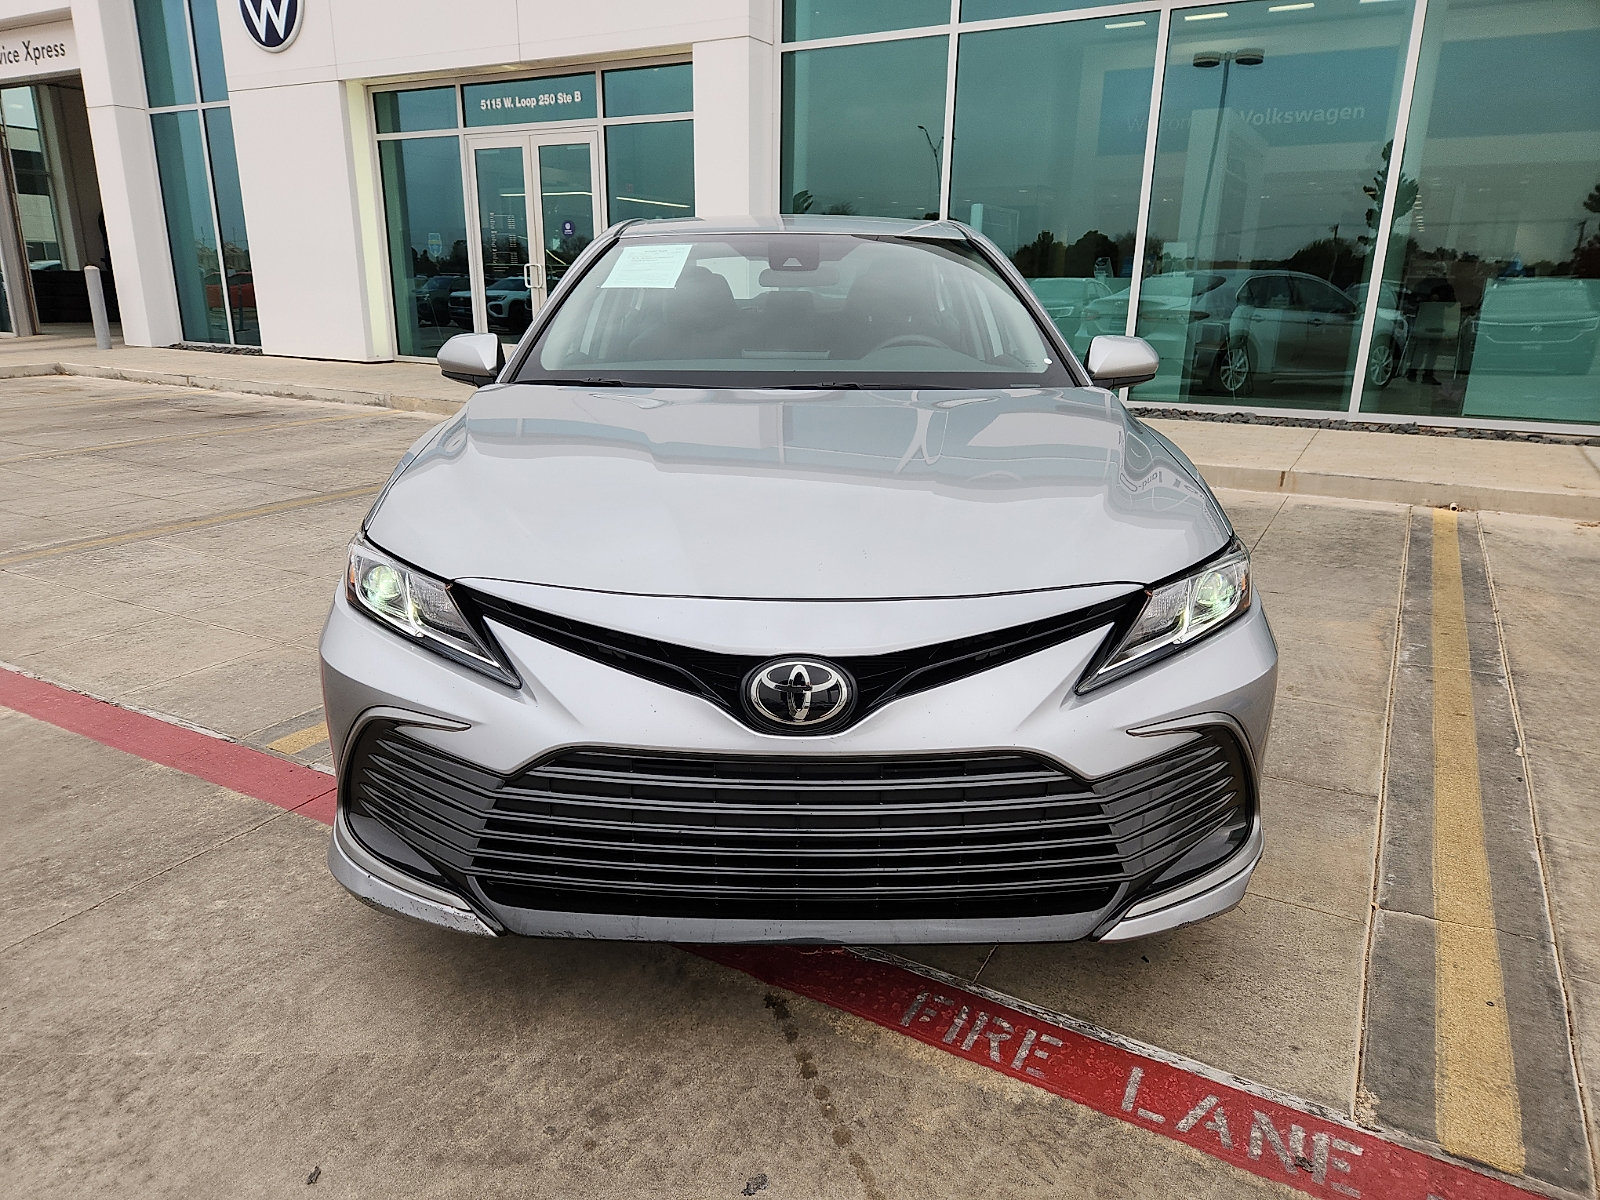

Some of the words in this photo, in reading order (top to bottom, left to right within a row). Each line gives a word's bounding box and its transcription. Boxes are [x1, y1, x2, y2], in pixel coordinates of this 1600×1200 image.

[22, 40, 66, 65] Xpress
[480, 98, 501, 110] 5115
[503, 97, 514, 108] W.
[515, 96, 536, 108] Loop
[538, 94, 555, 106] 250
[557, 92, 572, 104] Ste
[574, 90, 582, 102] B
[1240, 105, 1366, 125] Volkswagen
[900, 991, 1063, 1078] FIRE
[1121, 1066, 1364, 1199] LANE
